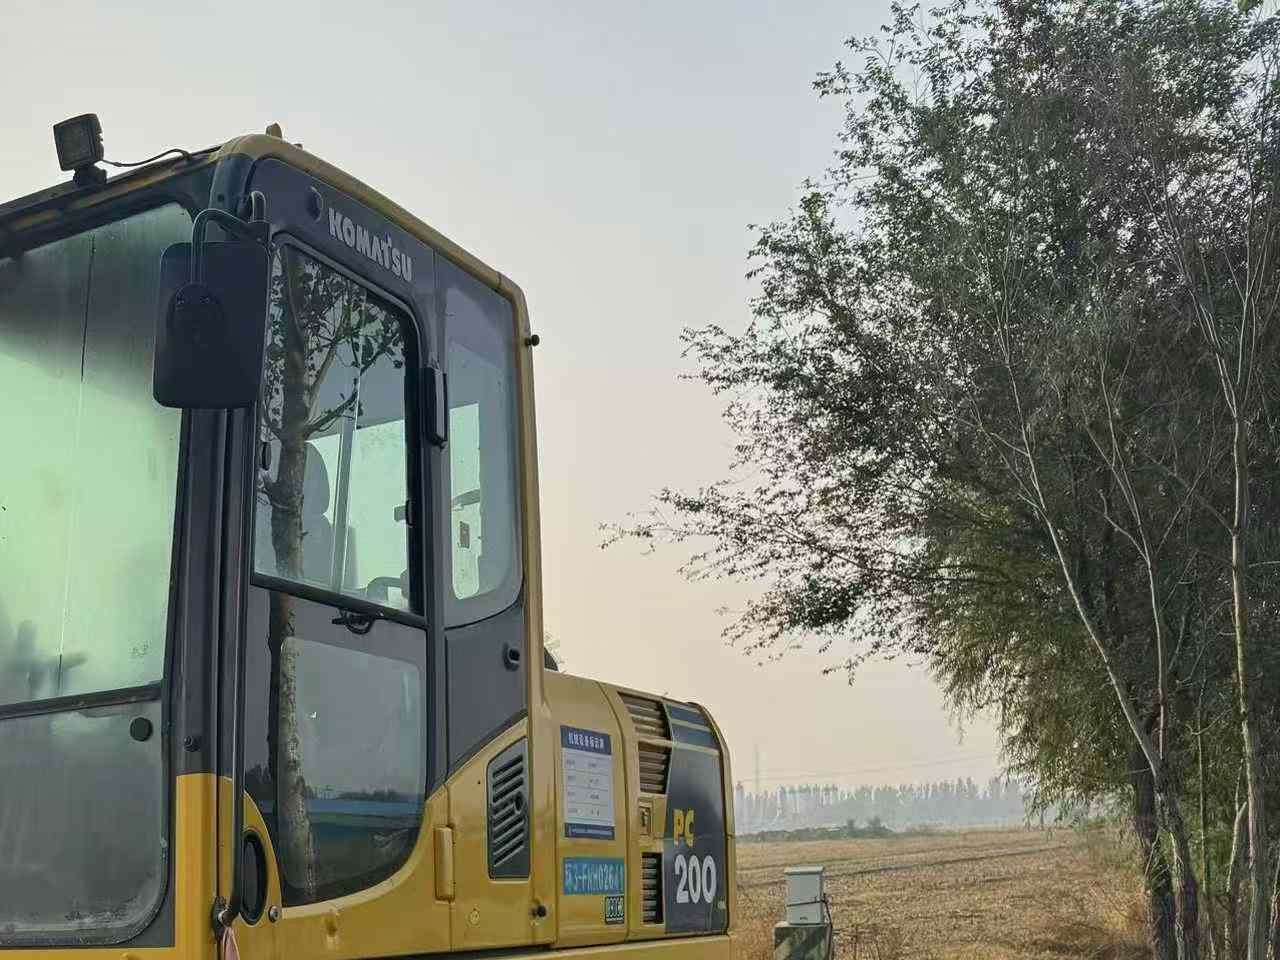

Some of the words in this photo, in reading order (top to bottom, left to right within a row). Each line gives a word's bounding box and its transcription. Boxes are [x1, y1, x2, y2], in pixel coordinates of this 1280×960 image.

[328, 207, 412, 281] KOMATSU
[673, 808, 695, 847] PC
[674, 854, 716, 904] 200
